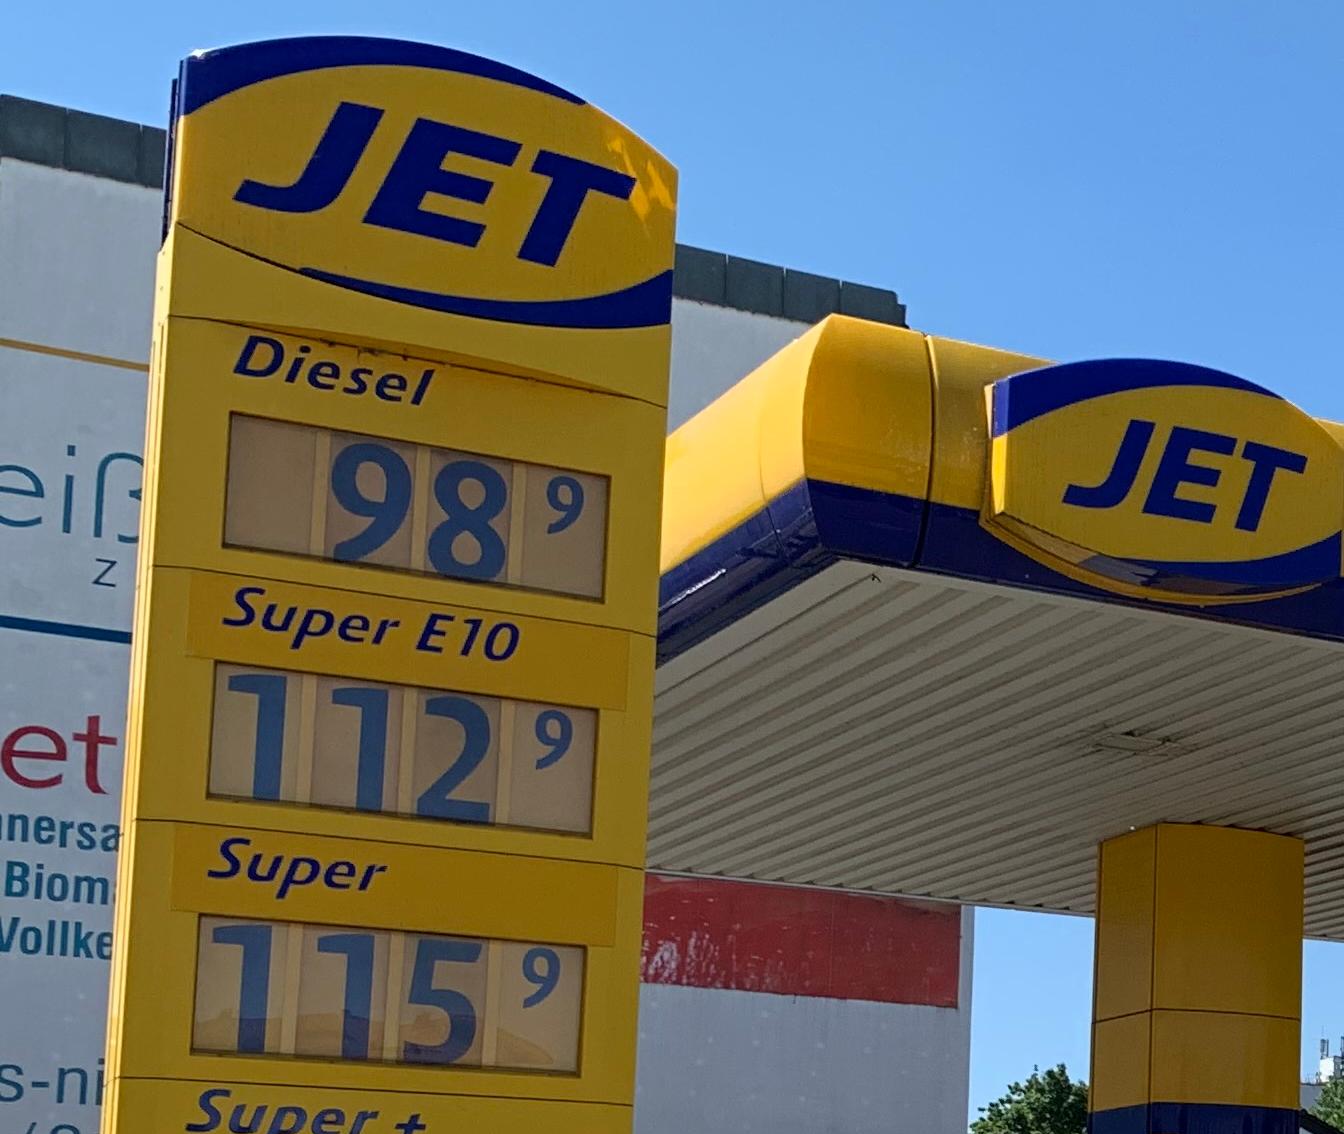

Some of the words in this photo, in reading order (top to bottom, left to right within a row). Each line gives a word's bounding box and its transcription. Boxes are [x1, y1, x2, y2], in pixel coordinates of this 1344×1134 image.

[232, 101, 636, 267] JET
[233, 335, 434, 406] Diesel
[1061, 418, 1308, 532] JET
[223, 586, 401, 650] Super
[416, 616, 520, 661] E10
[1, 715, 118, 794] et
[0, 812, 121, 853] nersa
[207, 838, 388, 899] Super
[4, 860, 116, 906] Biom
